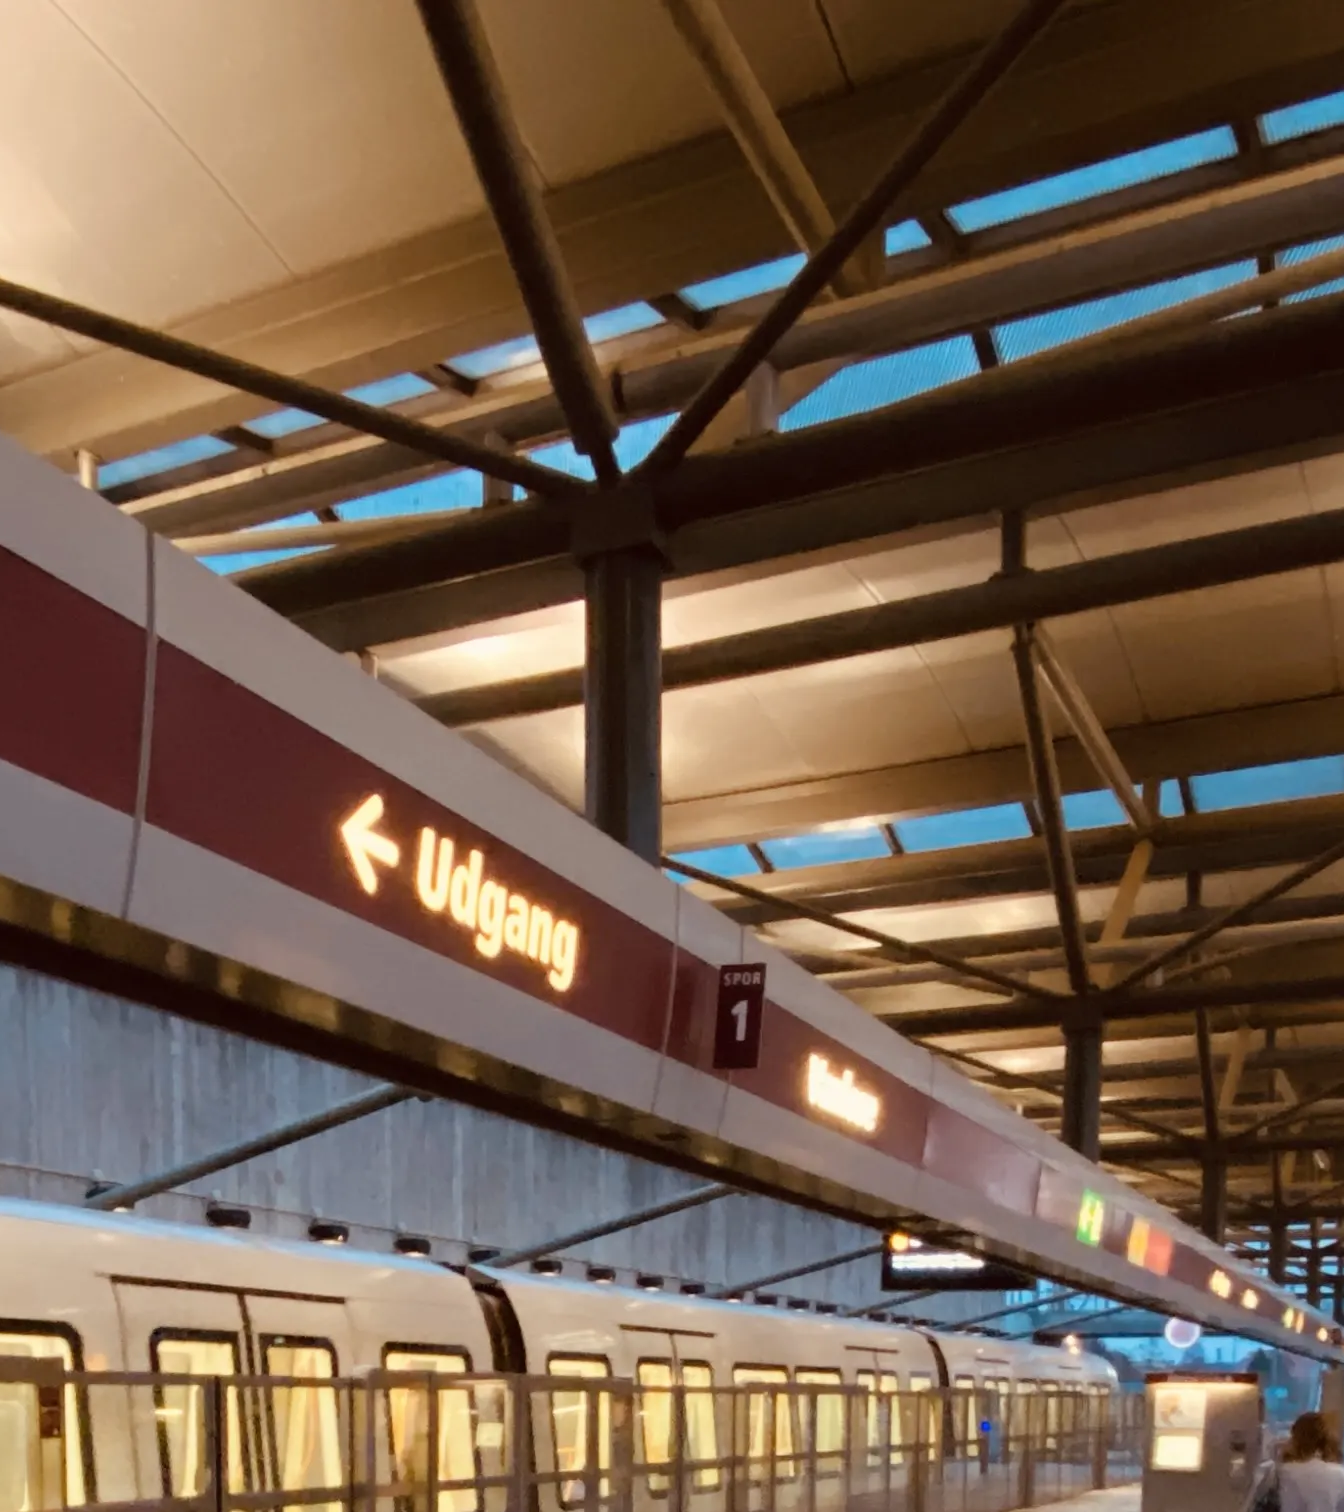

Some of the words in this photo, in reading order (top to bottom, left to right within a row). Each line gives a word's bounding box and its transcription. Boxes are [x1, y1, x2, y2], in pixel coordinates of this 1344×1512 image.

[416, 826, 579, 992] Udgang
[723, 971, 761, 987] SPOR
[731, 999, 748, 1041] 1
